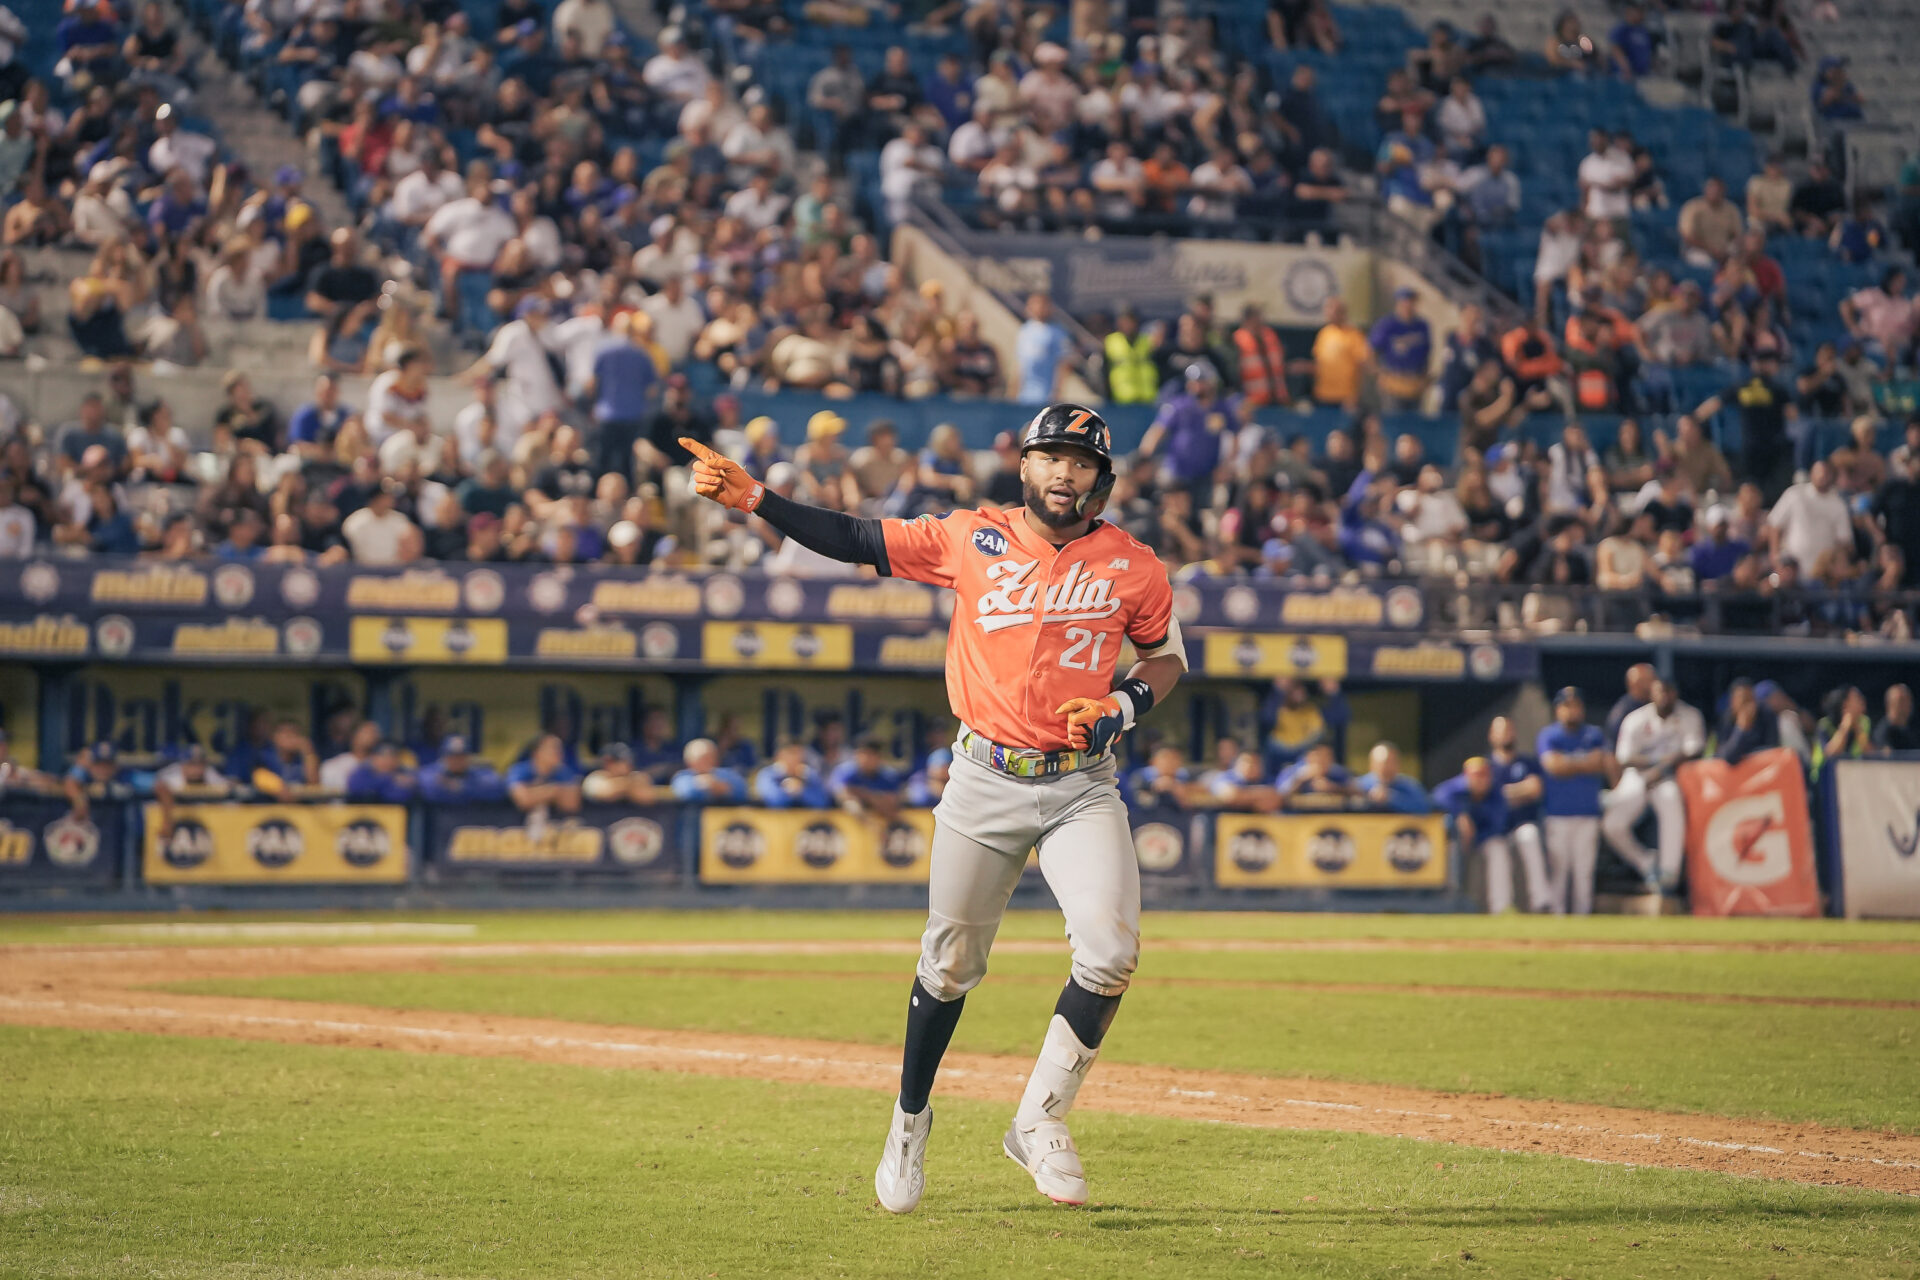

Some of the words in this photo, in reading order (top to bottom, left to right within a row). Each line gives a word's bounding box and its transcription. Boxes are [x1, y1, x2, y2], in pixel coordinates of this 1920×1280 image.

[1064, 409, 1093, 434] Z
[977, 559, 1121, 628] Zulia
[1059, 627, 1107, 671] 21
[1706, 791, 1792, 885] G
